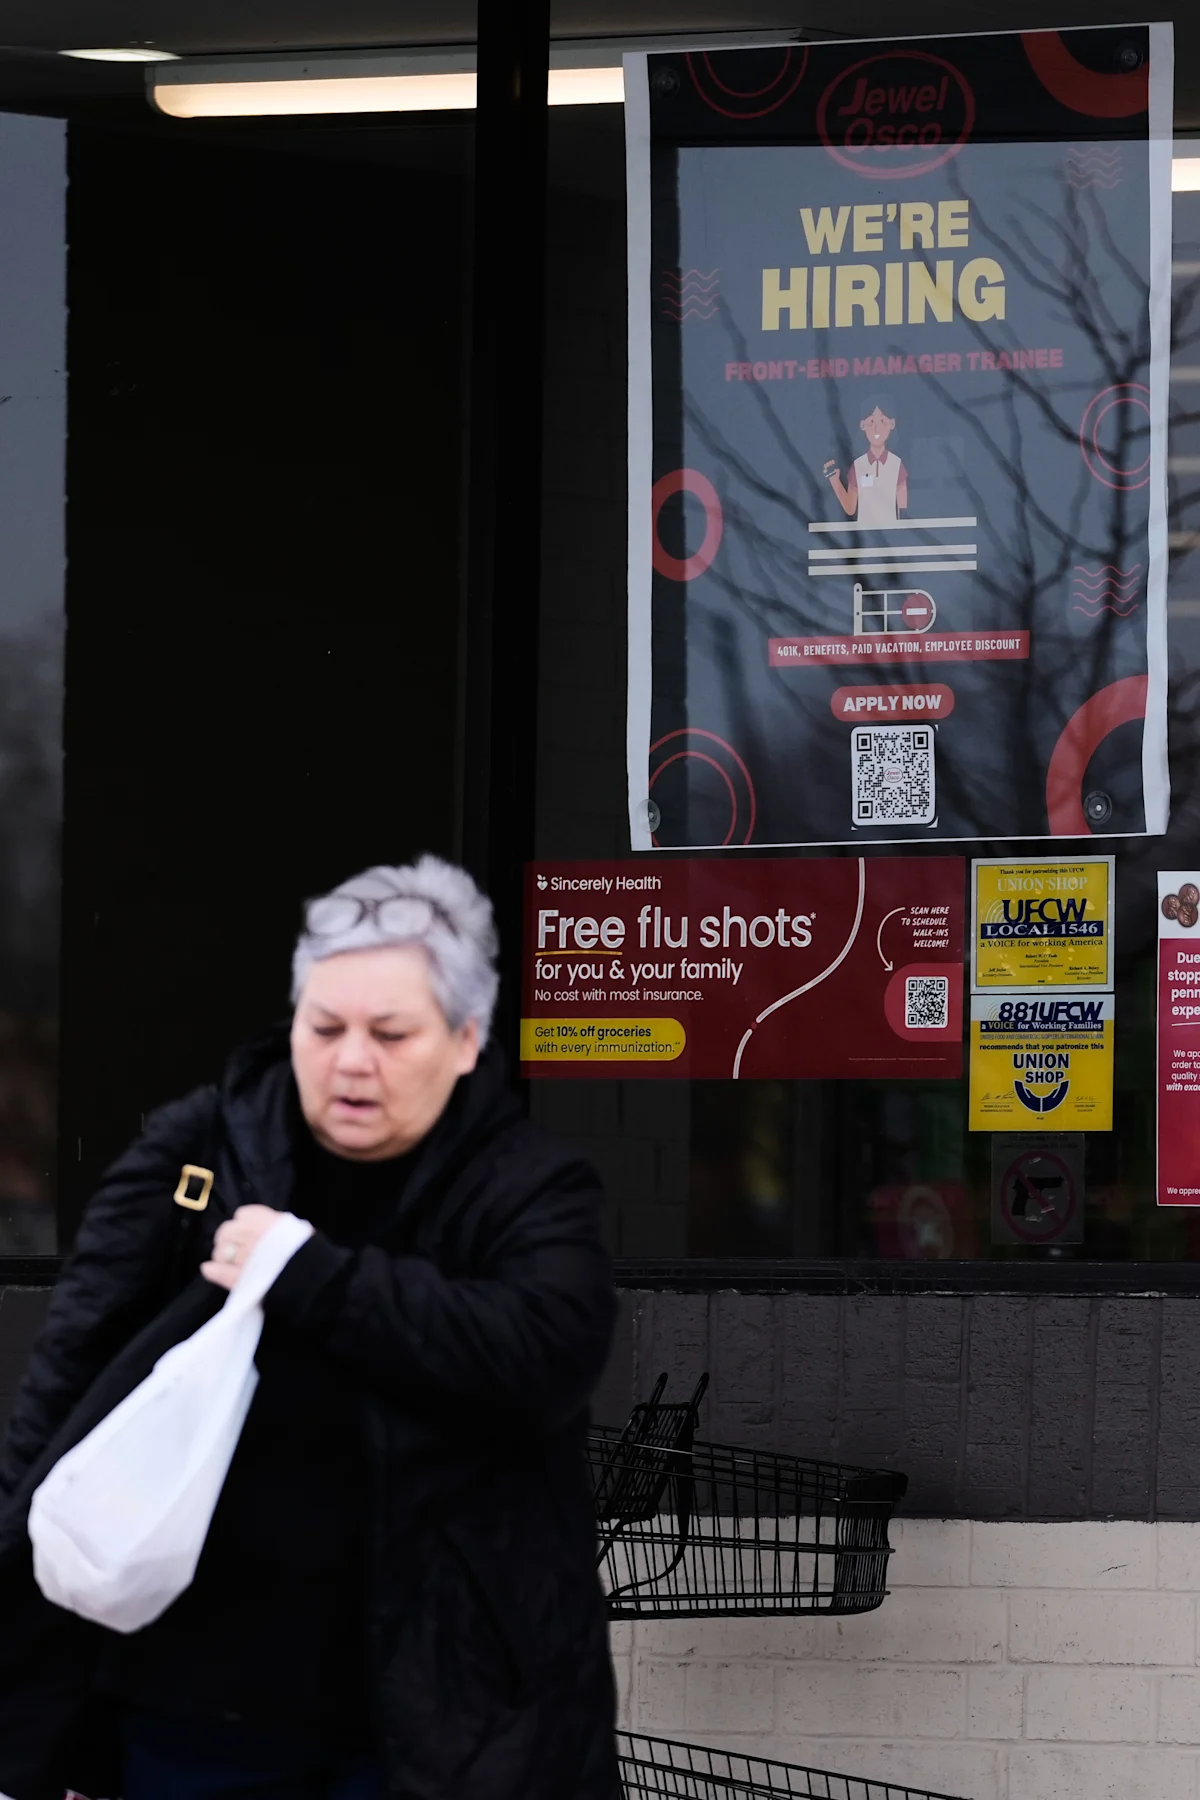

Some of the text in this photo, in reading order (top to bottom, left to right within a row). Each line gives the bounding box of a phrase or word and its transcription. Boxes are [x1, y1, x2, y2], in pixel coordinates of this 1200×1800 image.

[838, 76, 948, 116] Jewel
[844, 118, 942, 154] Osco
[800, 200, 969, 254] WE'RE
[762, 258, 1006, 330] HIRING
[725, 349, 1063, 382] FRONT-END MANAGER TRAINEE
[777, 639, 1020, 657] 401K, BENEFITS, PAID VACATION, EMPLOYEE DISCOUNT
[844, 694, 942, 712] APPLY NOW
[550, 876, 662, 894] Sincerely Health
[997, 876, 1088, 892] UNION SHOP
[1002, 898, 1087, 923] UFCW
[538, 910, 626, 949] Free
[637, 905, 688, 948] flu
[901, 918, 910, 926] TO
[986, 922, 1098, 936] LOCAL 1546
[913, 928, 948, 936] WALK-INS
[914, 940, 950, 948] WELCOME!
[1032, 939, 1066, 948] working
[1177, 952, 1200, 964] Due
[536, 958, 744, 986] for you & your family
[535, 988, 704, 1001] No cost with most insurance.
[1172, 1006, 1200, 1019] expe
[535, 1026, 651, 1040] Get 10% off groceries
[1032, 1022, 1066, 1031] Working
[535, 1042, 558, 1052] with
[561, 1044, 592, 1056] every
[1013, 1054, 1069, 1069] UNION
[1025, 1071, 1064, 1084] SHOP
[1172, 1072, 1197, 1082] quality
[1166, 1082, 1183, 1091] with
